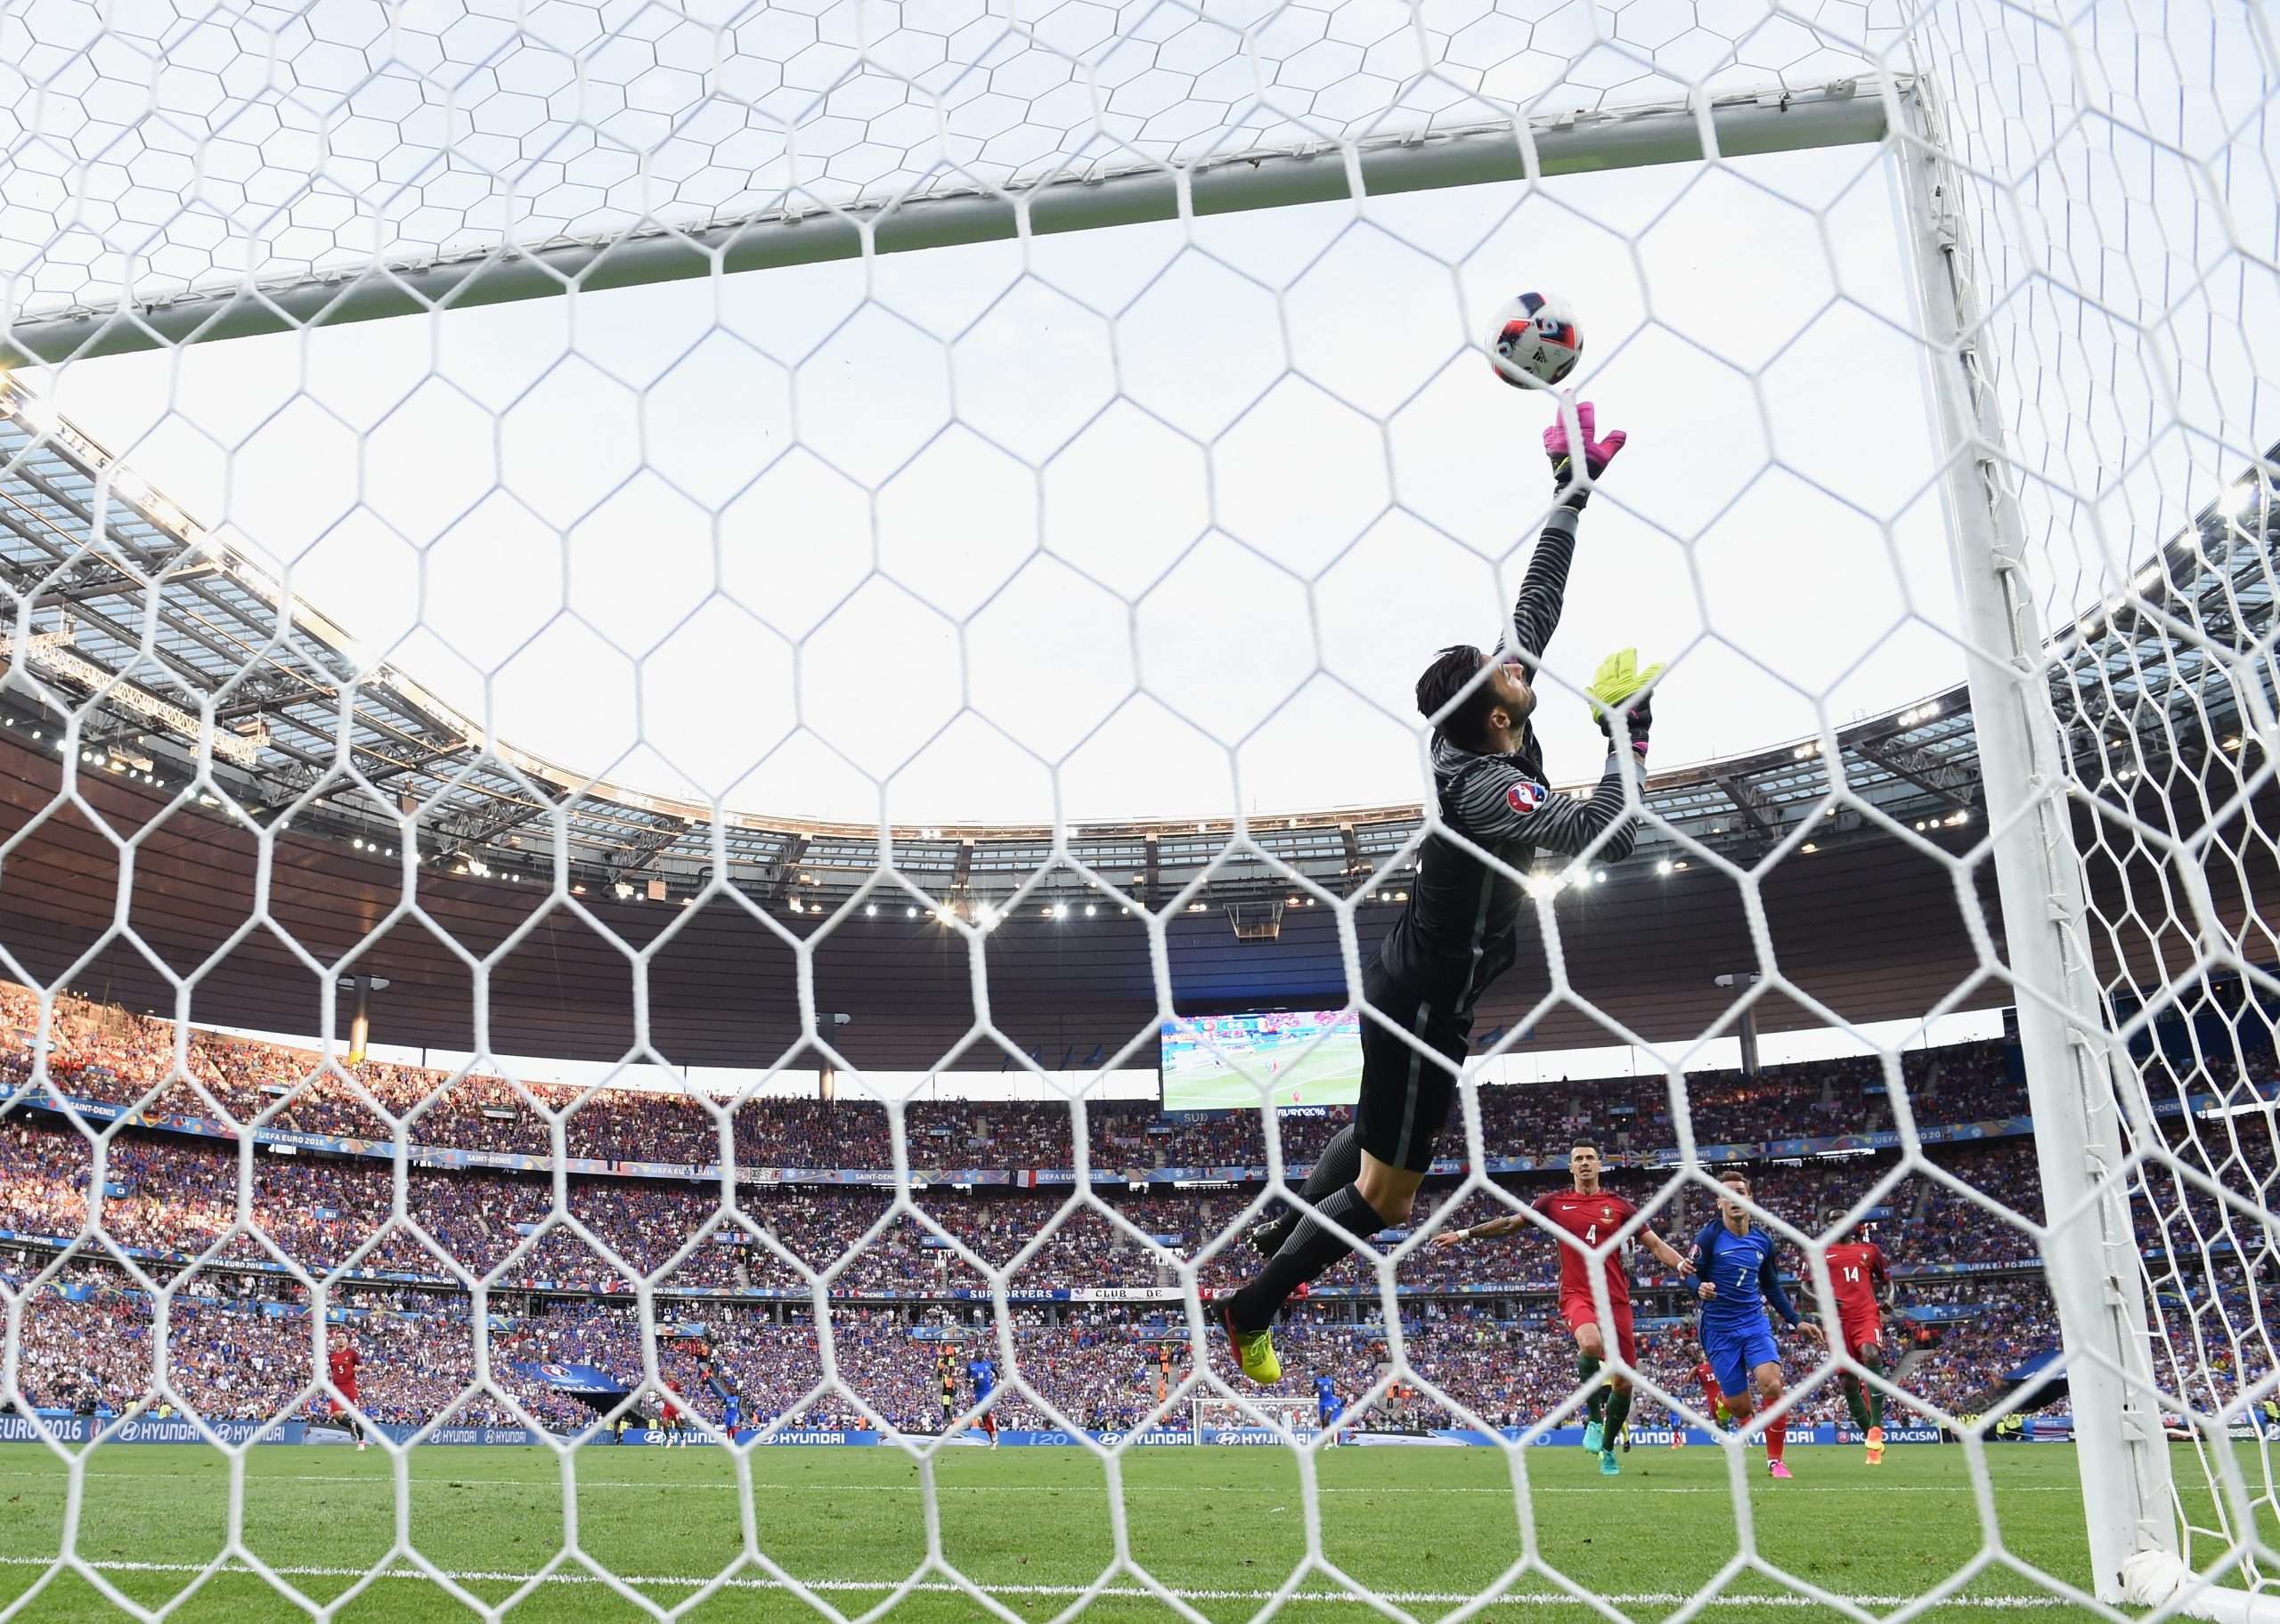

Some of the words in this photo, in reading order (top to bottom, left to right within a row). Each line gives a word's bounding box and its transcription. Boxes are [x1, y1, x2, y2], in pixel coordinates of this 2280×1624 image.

[1184, 1113, 1209, 1123] SUD
[258, 1133, 281, 1142] UEFA
[281, 1134, 305, 1145] EURO
[305, 1137, 326, 1147] 2016
[467, 1154, 512, 1165] SAINT-DENIS
[1585, 1224, 1598, 1245] 4
[224, 1260, 246, 1269] EURO
[1736, 1268, 1747, 1287] 7
[1843, 1266, 1860, 1283] 14
[969, 1289, 1054, 1298] SUPORTERS
[1095, 1289, 1127, 1299] CLUB
[1146, 1289, 1162, 1297] DE
[1481, 1284, 1503, 1292] UEFA
[338, 1365, 345, 1375] 5
[354, 1399, 359, 1408] 5
[45, 1418, 83, 1441] 2016
[141, 1422, 200, 1441] HYUNDAI
[443, 1430, 477, 1443] HYUNDAI
[495, 1431, 526, 1443] HYUNDAI
[779, 1433, 845, 1444] HYUNDAI
[1029, 1432, 1069, 1446] i20
[1125, 1433, 1192, 1445] YUNDAI
[1891, 1431, 1939, 1441] RACISM
